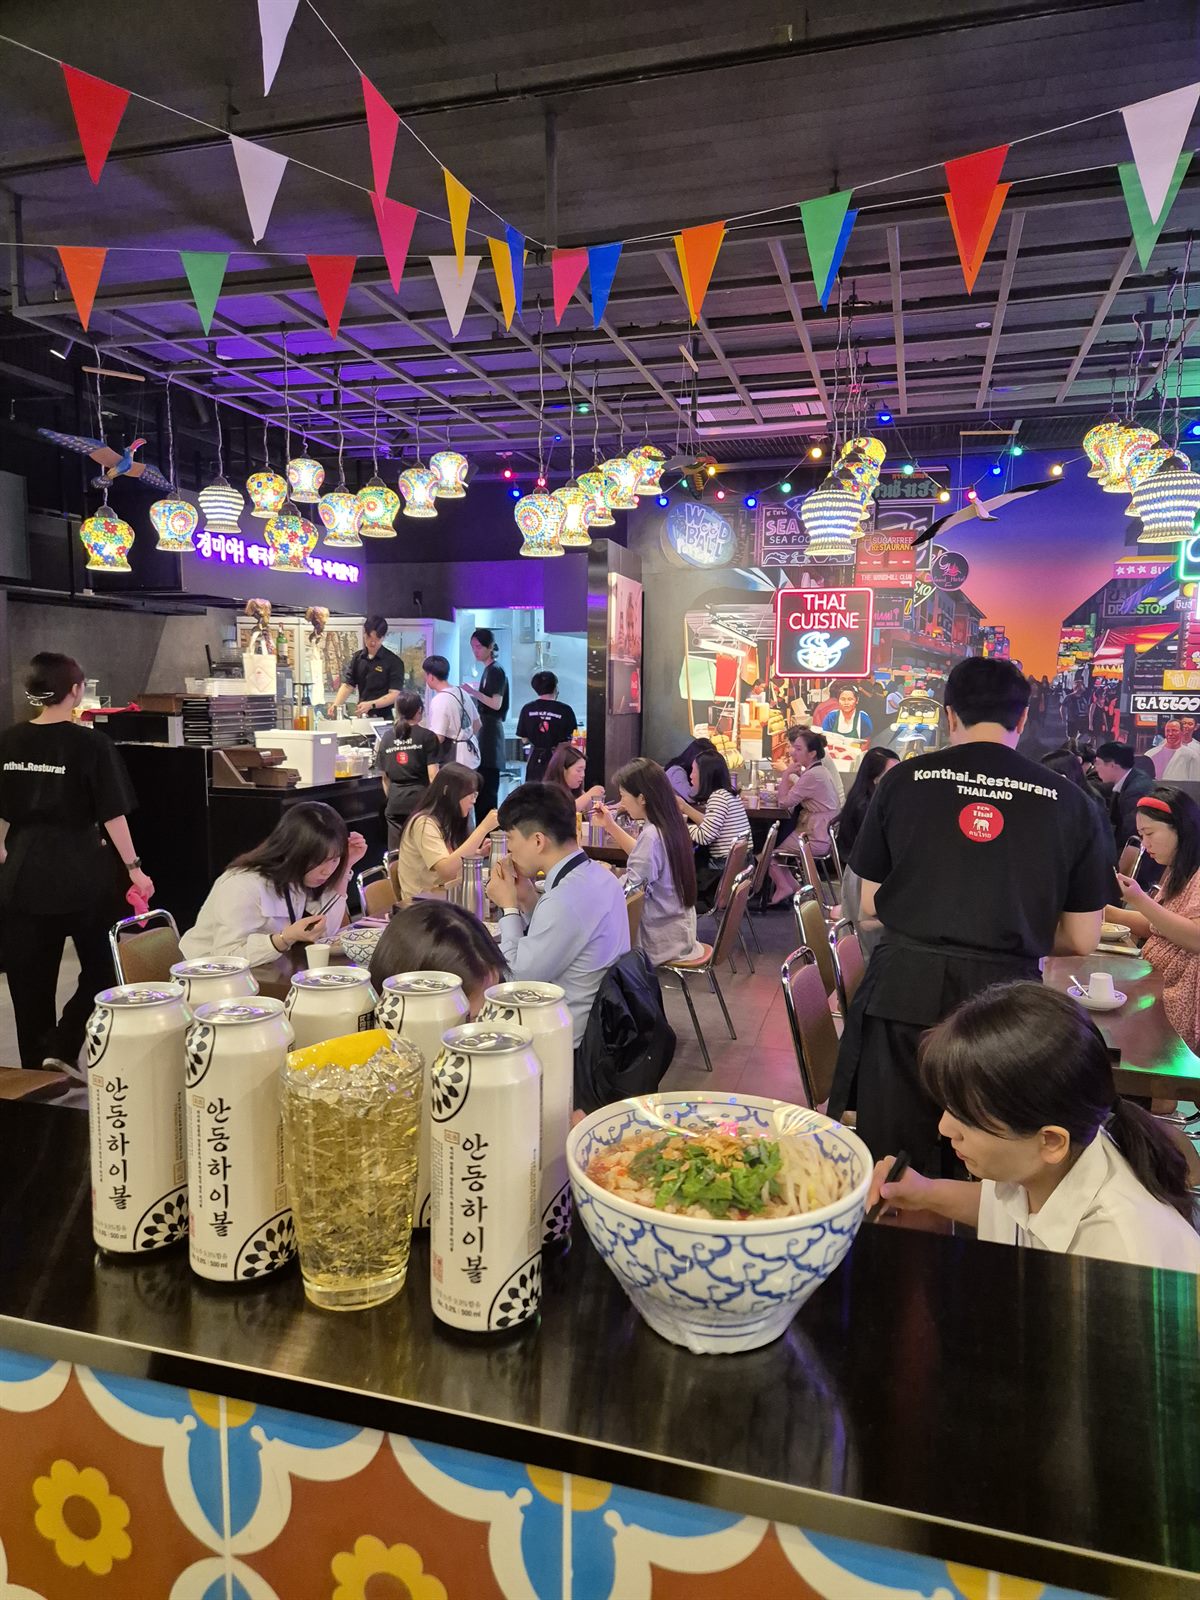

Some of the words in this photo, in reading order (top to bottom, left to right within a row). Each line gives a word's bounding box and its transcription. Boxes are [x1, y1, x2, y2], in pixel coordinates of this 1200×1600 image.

[769, 535, 788, 544] SEA
[791, 535, 811, 544] FOO
[803, 593, 846, 611] THAI
[788, 611, 859, 630] CUISINE
[914, 768, 1058, 800] Konthai_Restaurant
[956, 785, 1013, 801] THAILAND
[105, 1076, 132, 1210] 안동하이볼
[206, 1097, 234, 1237] 안동하이볼
[460, 1133, 489, 1284] 안동하이볼
